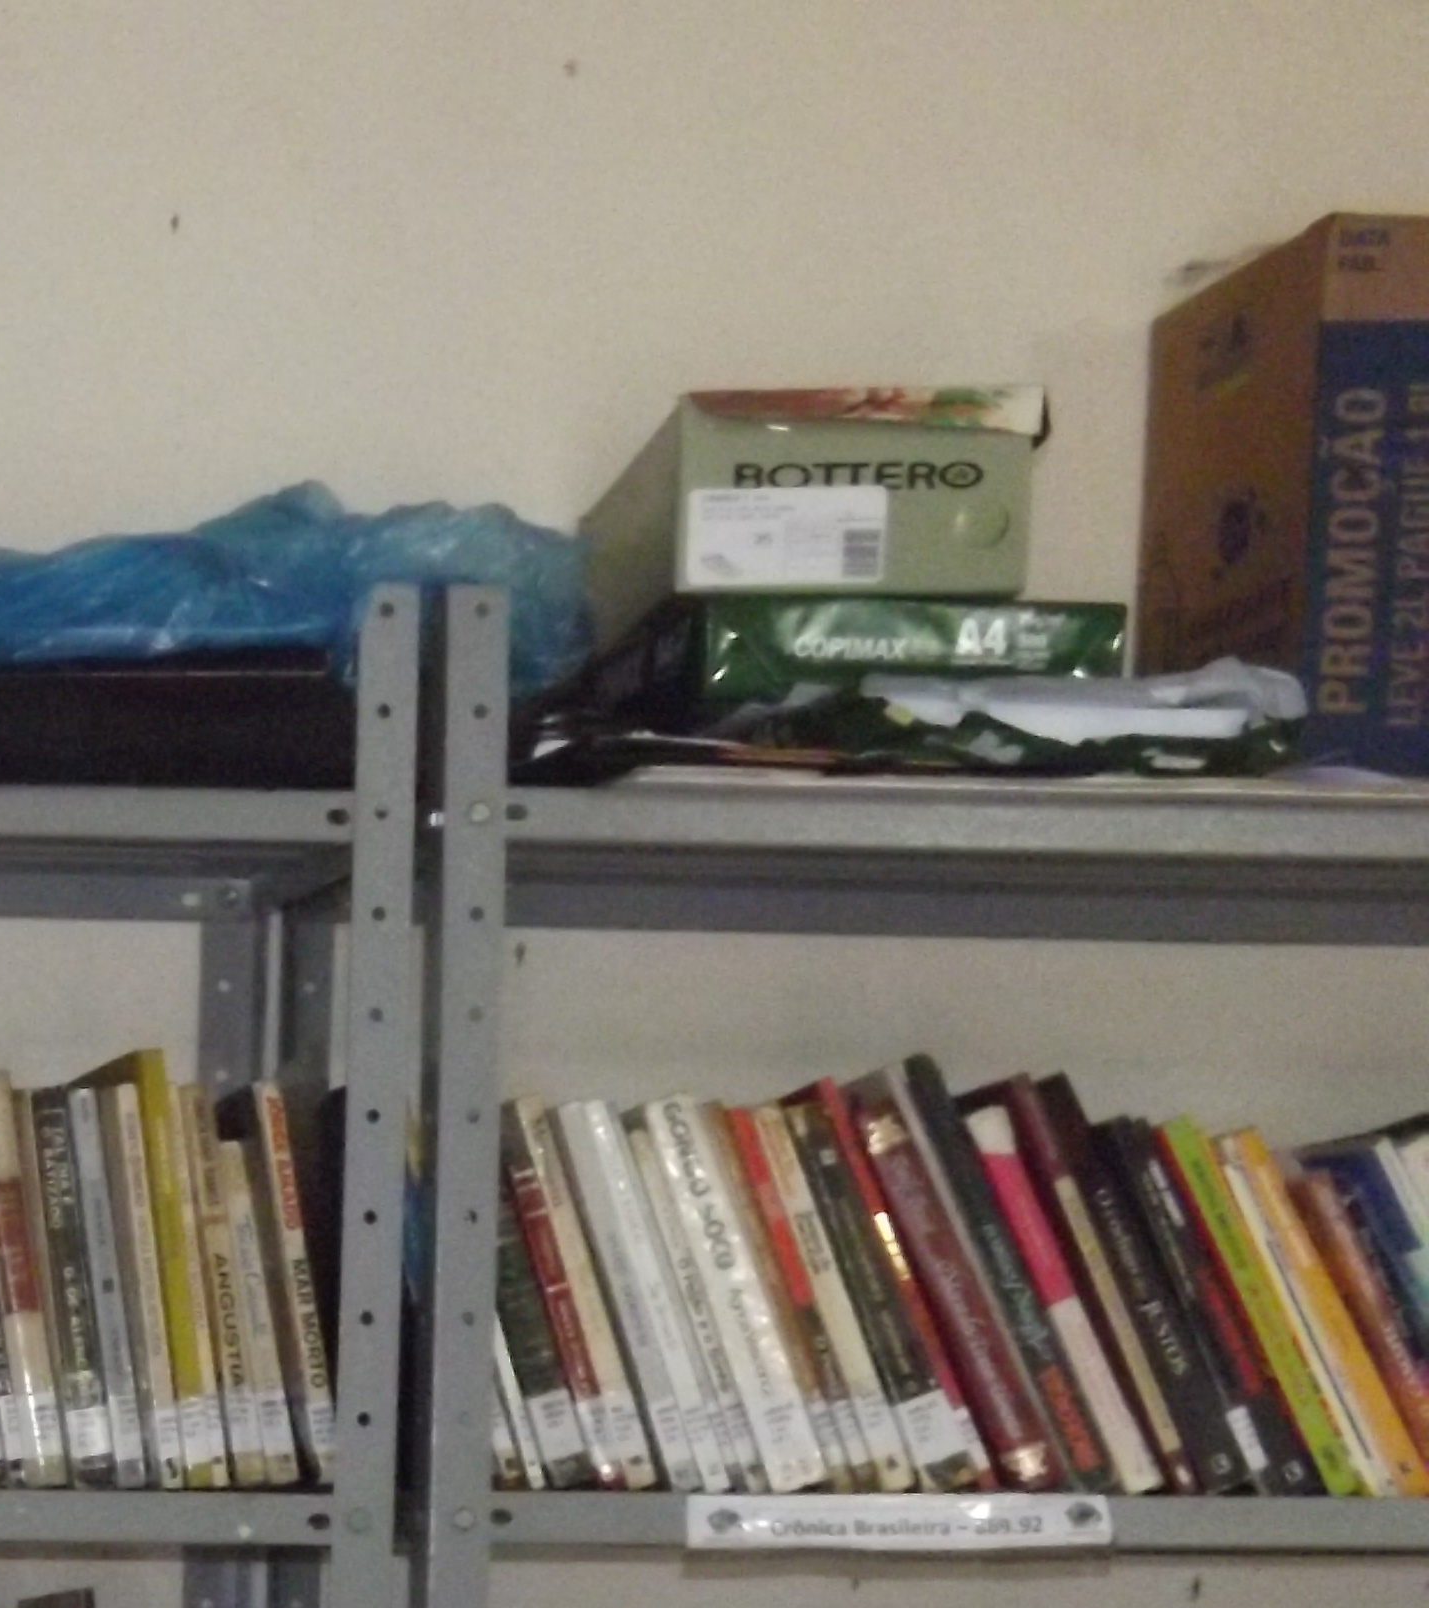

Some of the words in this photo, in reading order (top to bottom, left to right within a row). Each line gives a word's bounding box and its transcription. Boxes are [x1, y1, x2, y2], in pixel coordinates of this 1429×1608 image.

[733, 461, 983, 490] BOTTERO
[1317, 386, 1395, 718] PROMOÇÃO
[795, 636, 908, 660] COPIMAX
[955, 617, 1007, 655] A4
[289, 1255, 315, 1306] MAR
[297, 1310, 329, 1389] MORTO
[770, 1516, 846, 1539] Crônica
[853, 1512, 951, 1537] Brasileira
